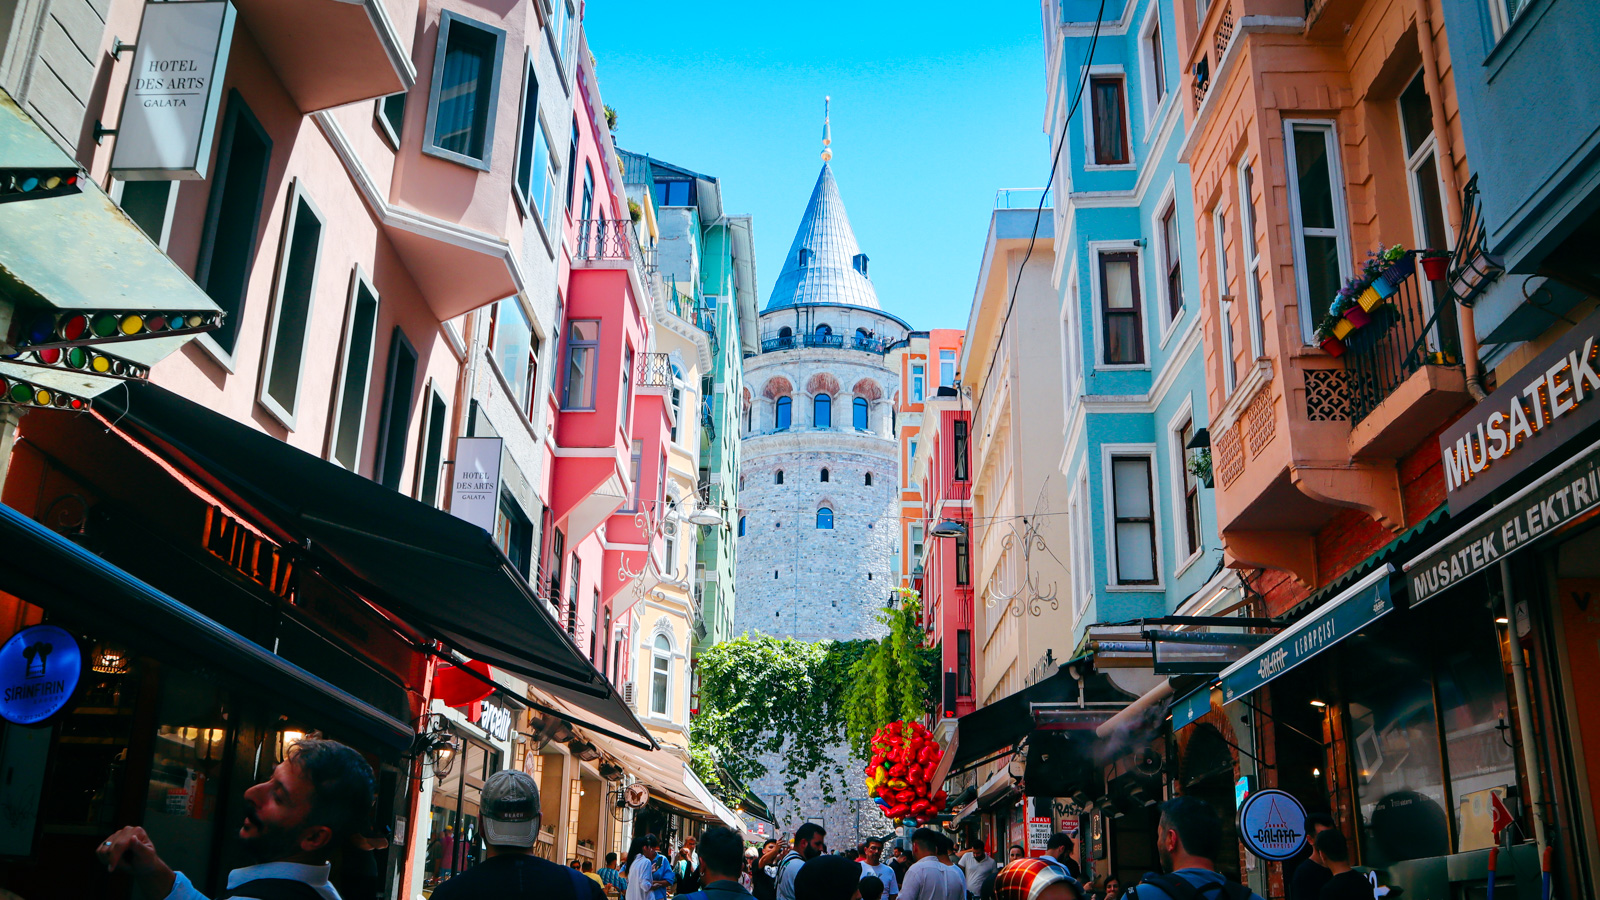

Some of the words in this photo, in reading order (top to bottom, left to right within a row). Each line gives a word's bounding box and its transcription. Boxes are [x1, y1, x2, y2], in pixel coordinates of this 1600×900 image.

[149, 60, 198, 72] HOTEL
[135, 78, 163, 91] DES
[167, 77, 205, 90] ARTS
[143, 98, 187, 108] GALATA
[1444, 335, 1600, 492] MUSATEK
[456, 482, 473, 490] DES
[474, 482, 494, 490] ARTS
[1413, 532, 1499, 601] MUSATEK
[1502, 461, 1600, 551] ELEKTRİ
[1294, 617, 1336, 658] KEBAPÇISI
[1257, 829, 1296, 844] GALATA
